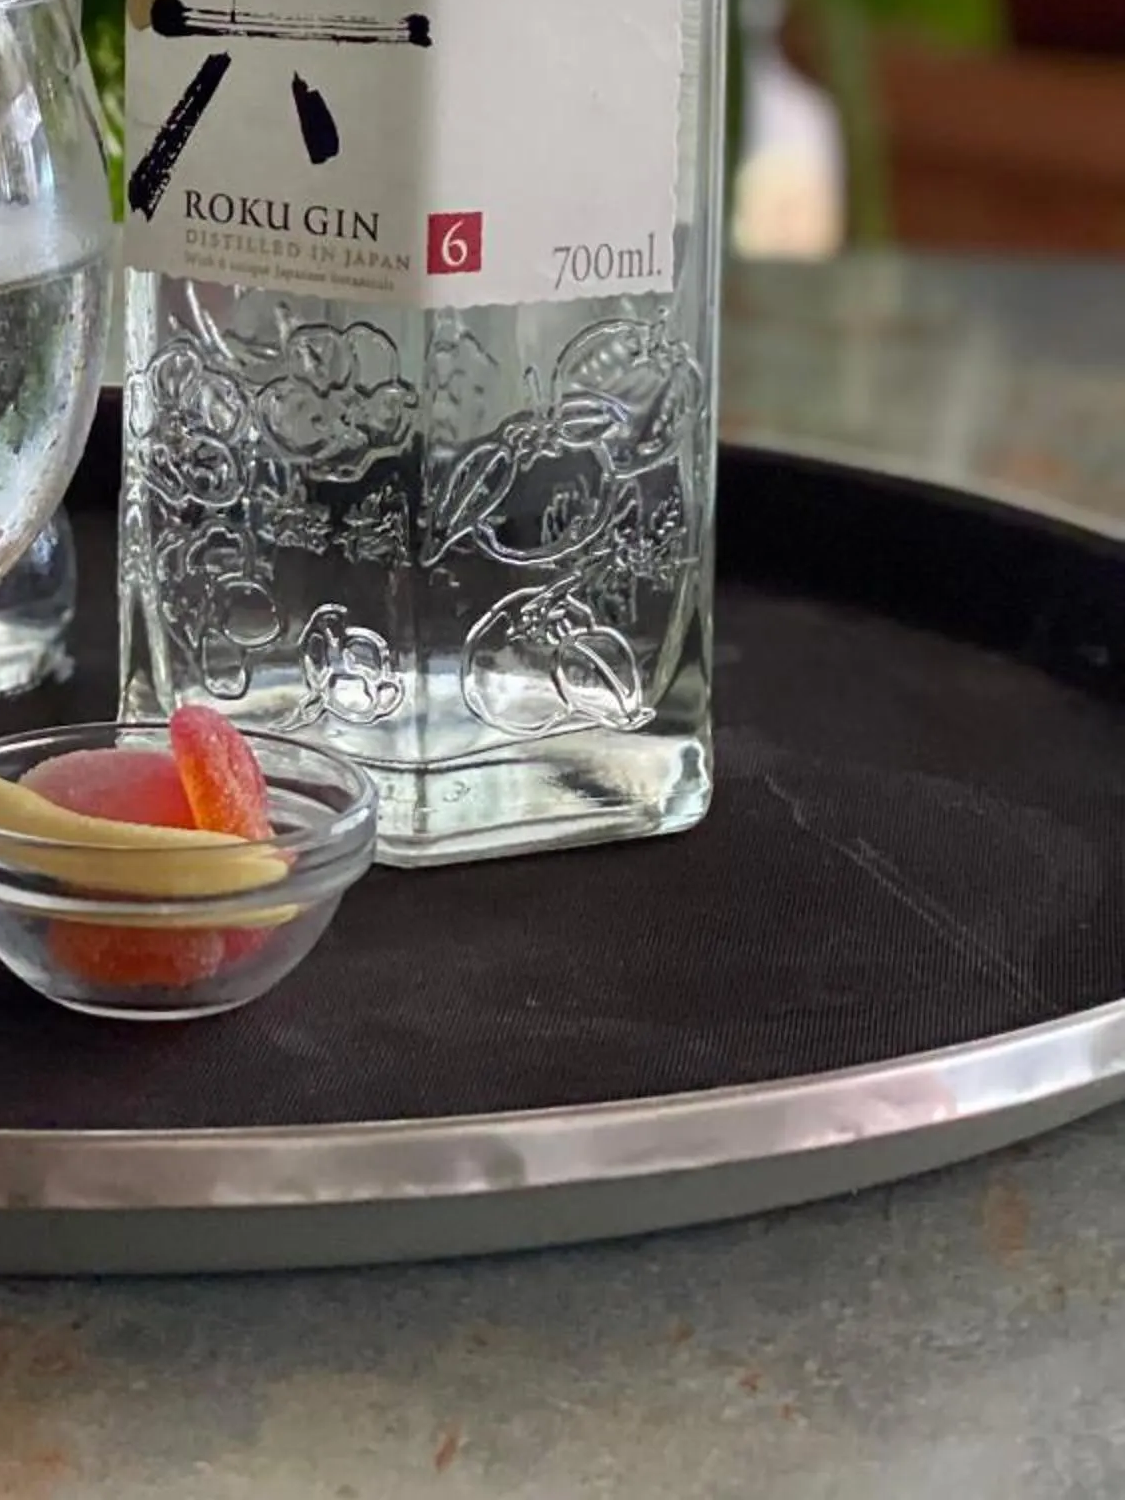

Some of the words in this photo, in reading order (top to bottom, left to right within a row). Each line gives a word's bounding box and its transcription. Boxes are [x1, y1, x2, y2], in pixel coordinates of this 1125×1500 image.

[185, 189, 291, 232] ROKU
[303, 205, 379, 242] GIN
[185, 228, 302, 259] DISTILLED
[311, 243, 335, 263] IN
[343, 247, 411, 271] JAPAN
[441, 218, 469, 267] 6
